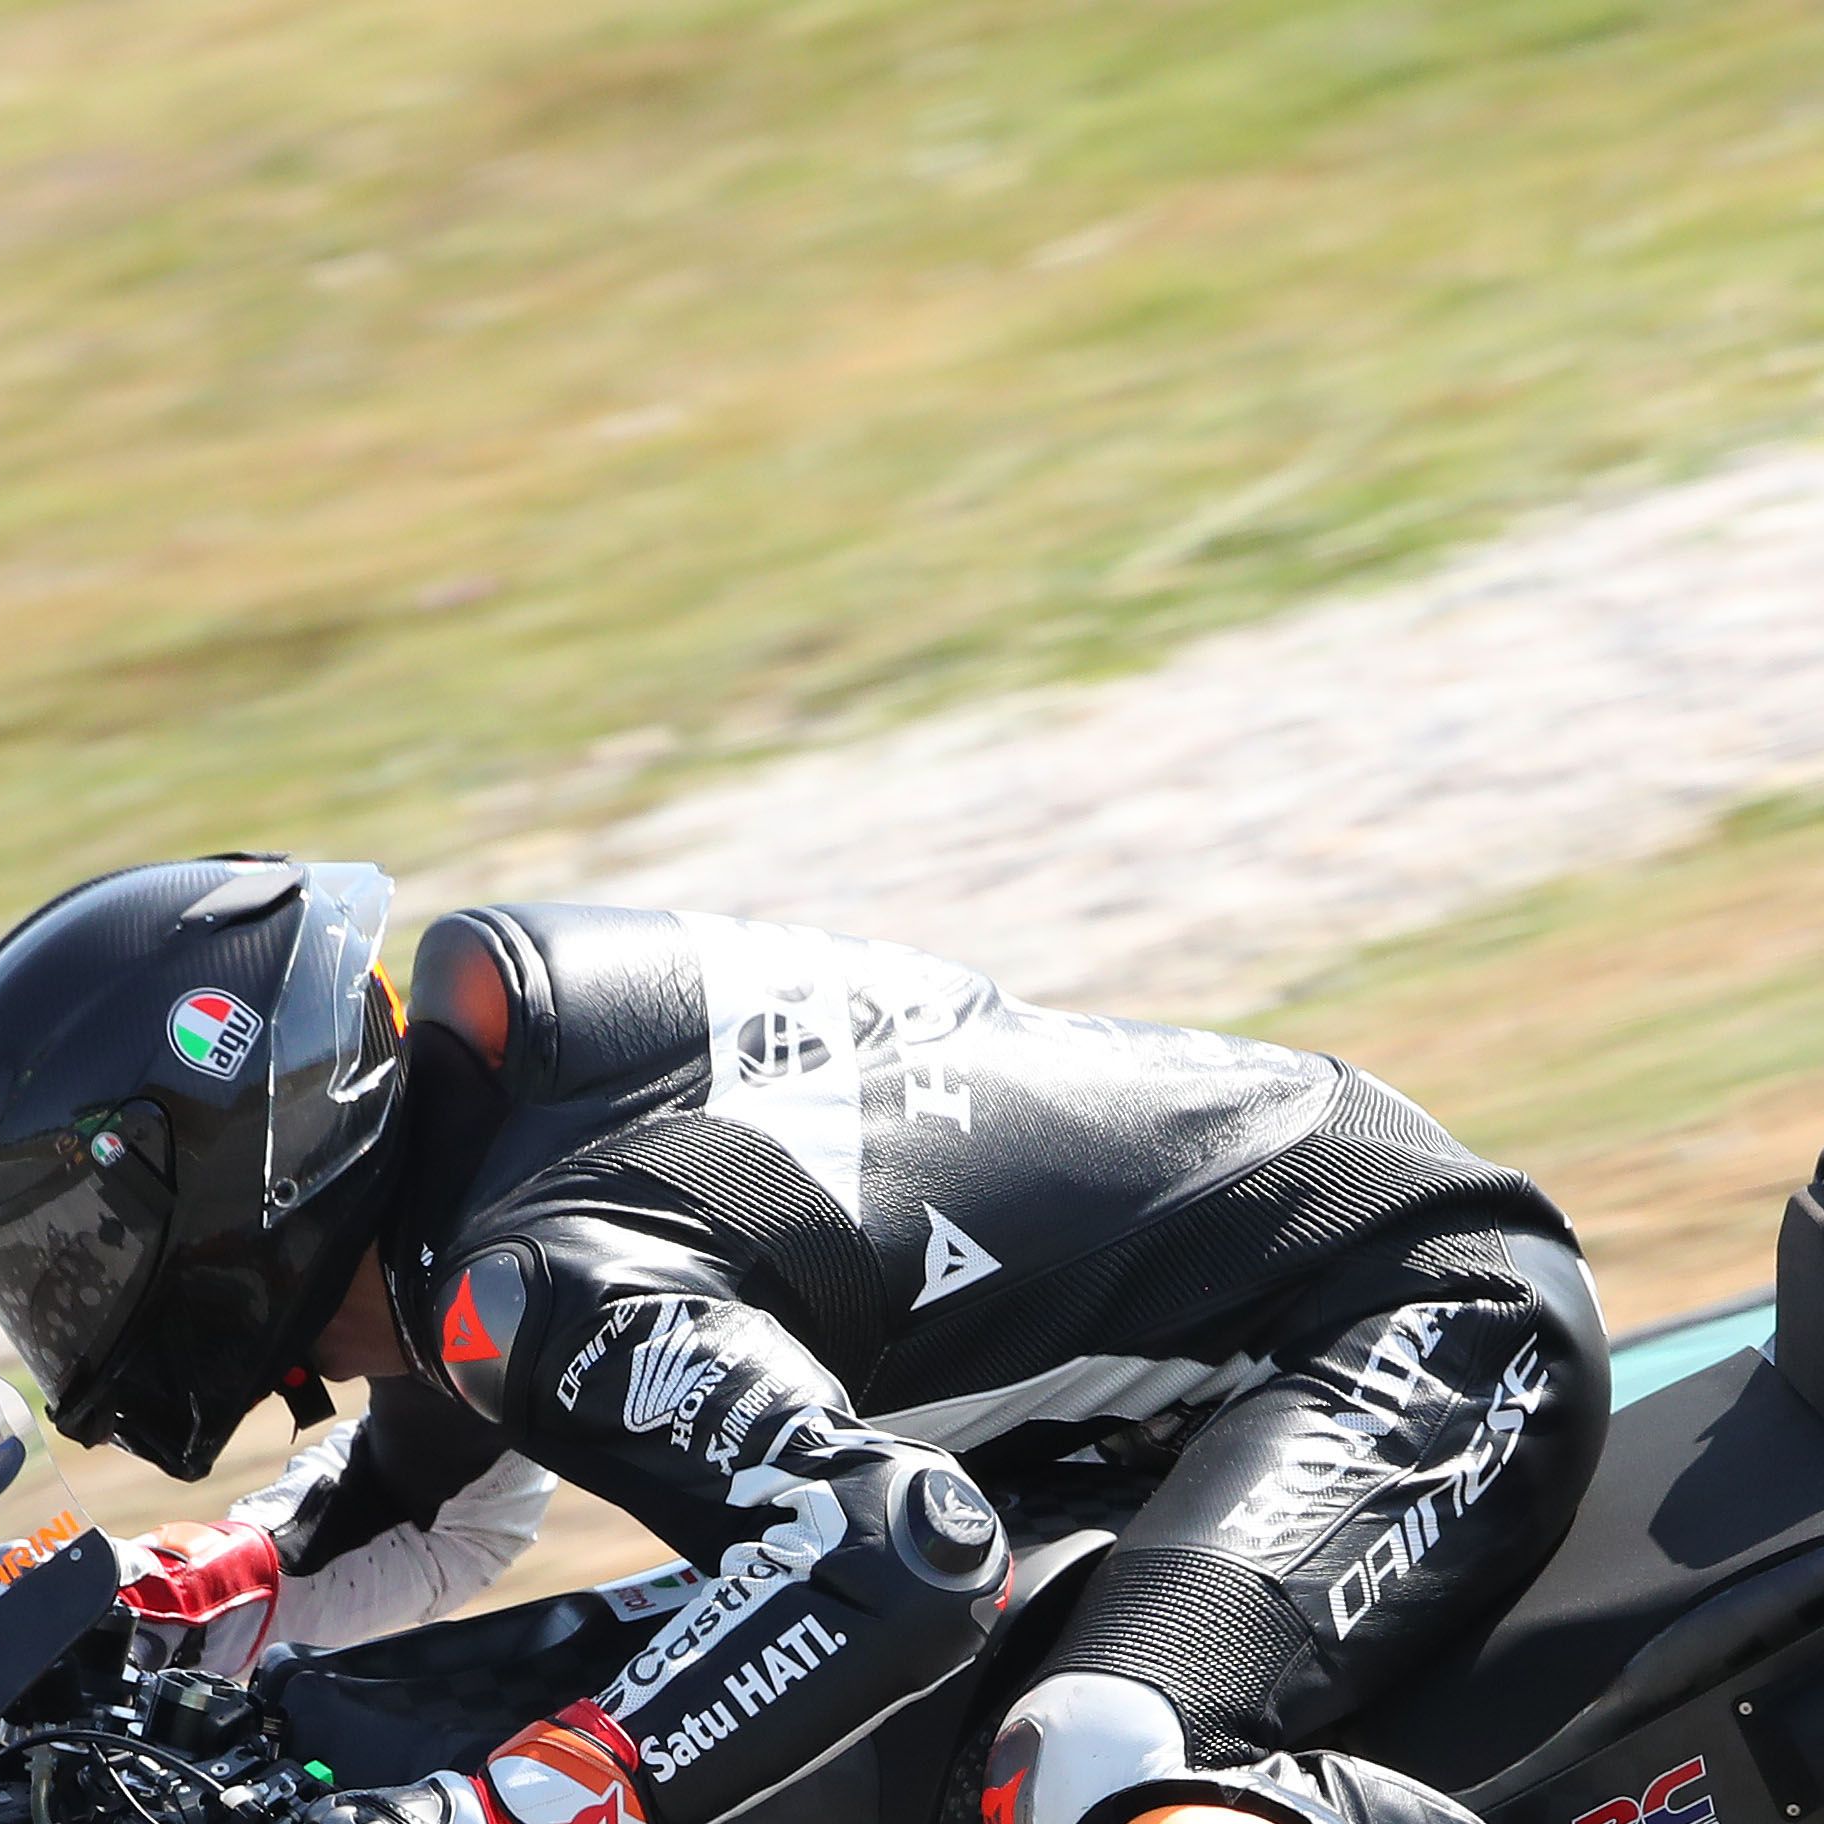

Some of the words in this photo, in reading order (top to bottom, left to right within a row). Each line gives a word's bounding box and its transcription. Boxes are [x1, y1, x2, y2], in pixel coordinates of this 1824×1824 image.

[627, 1547, 794, 1687] Castrol
[639, 1700, 740, 1784] Satu
[722, 1613, 848, 1718] HATI.
